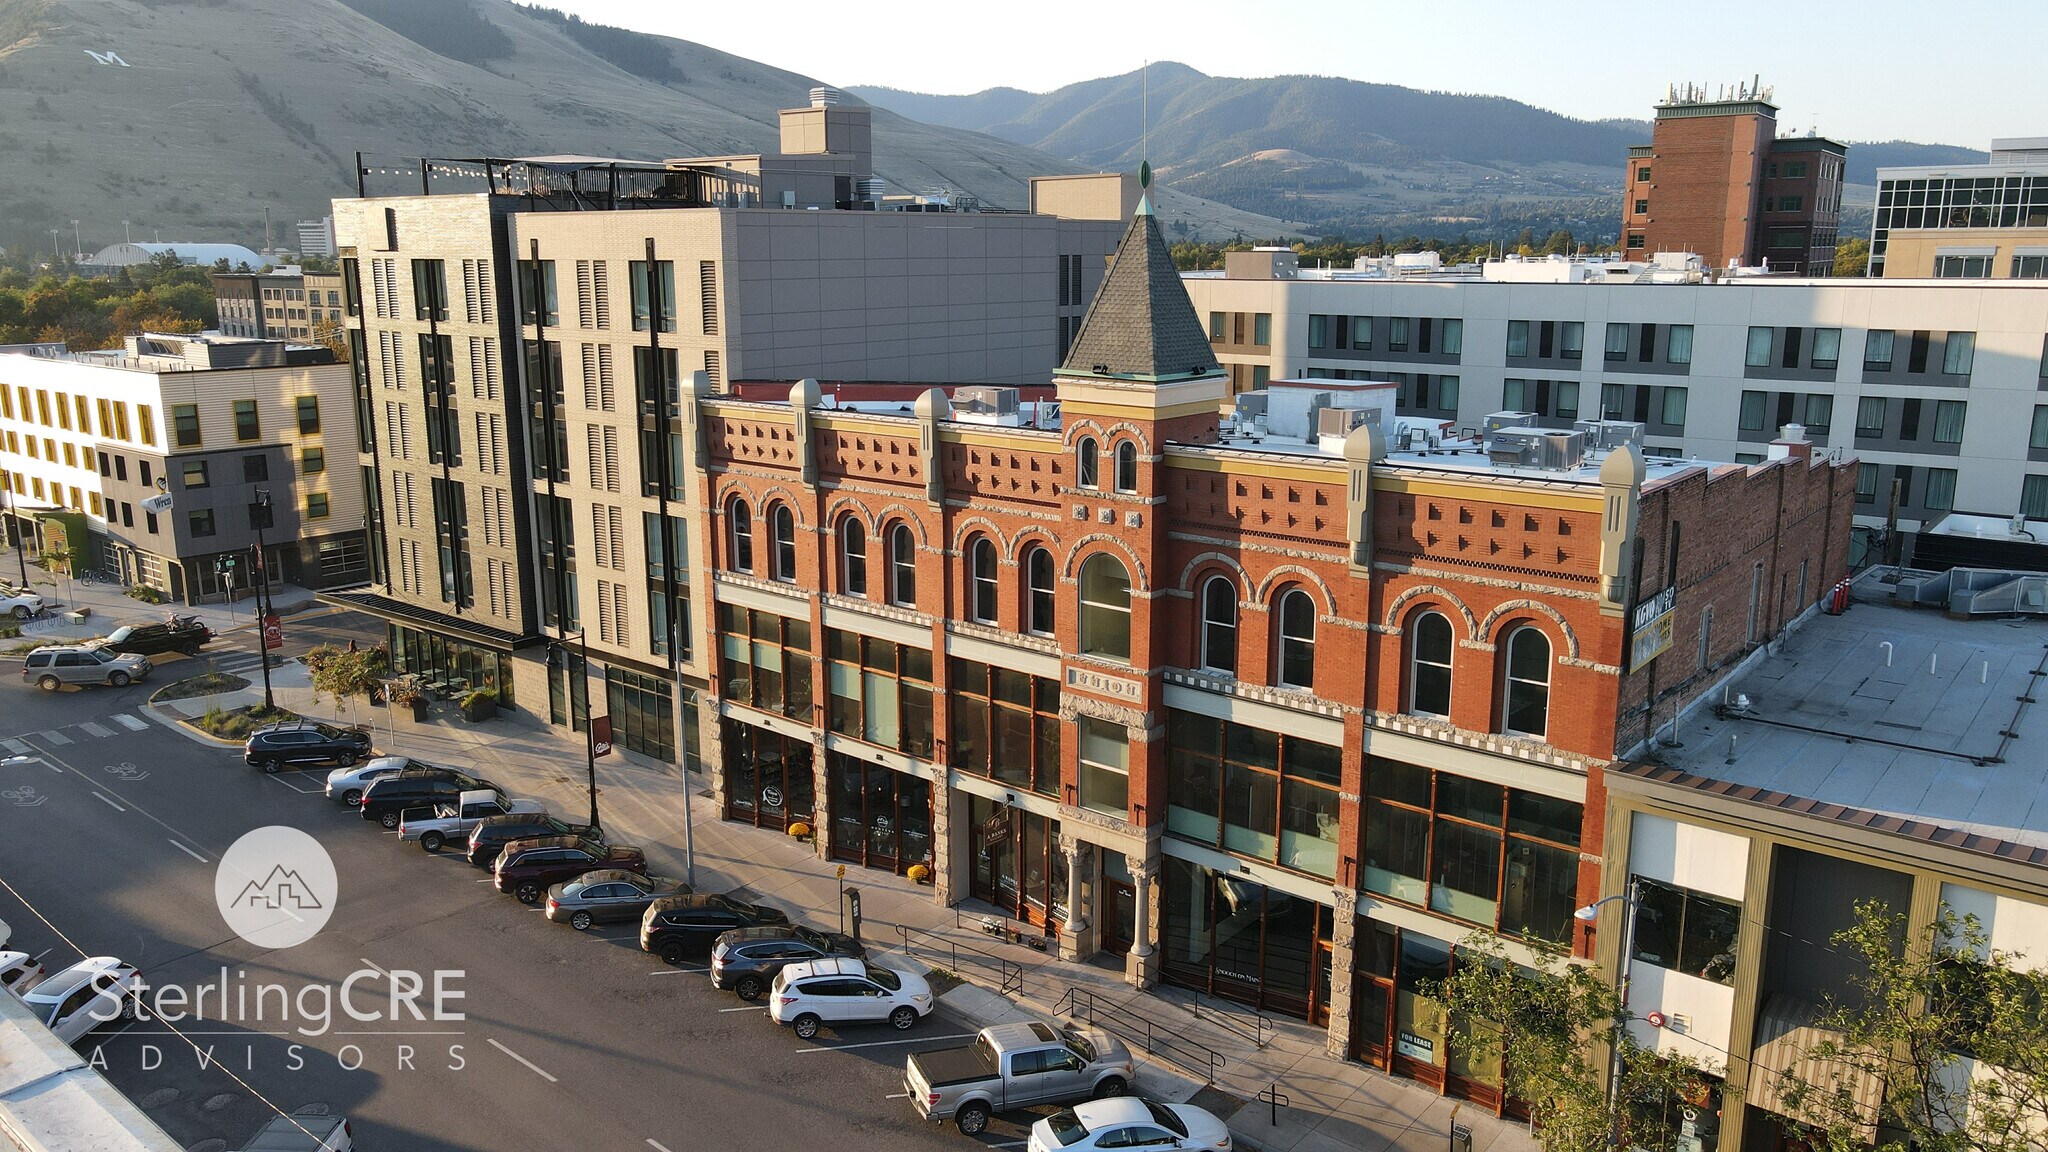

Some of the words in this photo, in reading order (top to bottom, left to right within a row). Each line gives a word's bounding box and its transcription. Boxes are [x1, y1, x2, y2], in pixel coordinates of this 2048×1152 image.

[84, 50, 131, 67] M
[154, 496, 172, 509] Wren
[1401, 1032, 1413, 1042] FOR
[1413, 1036, 1432, 1049] LEASE
